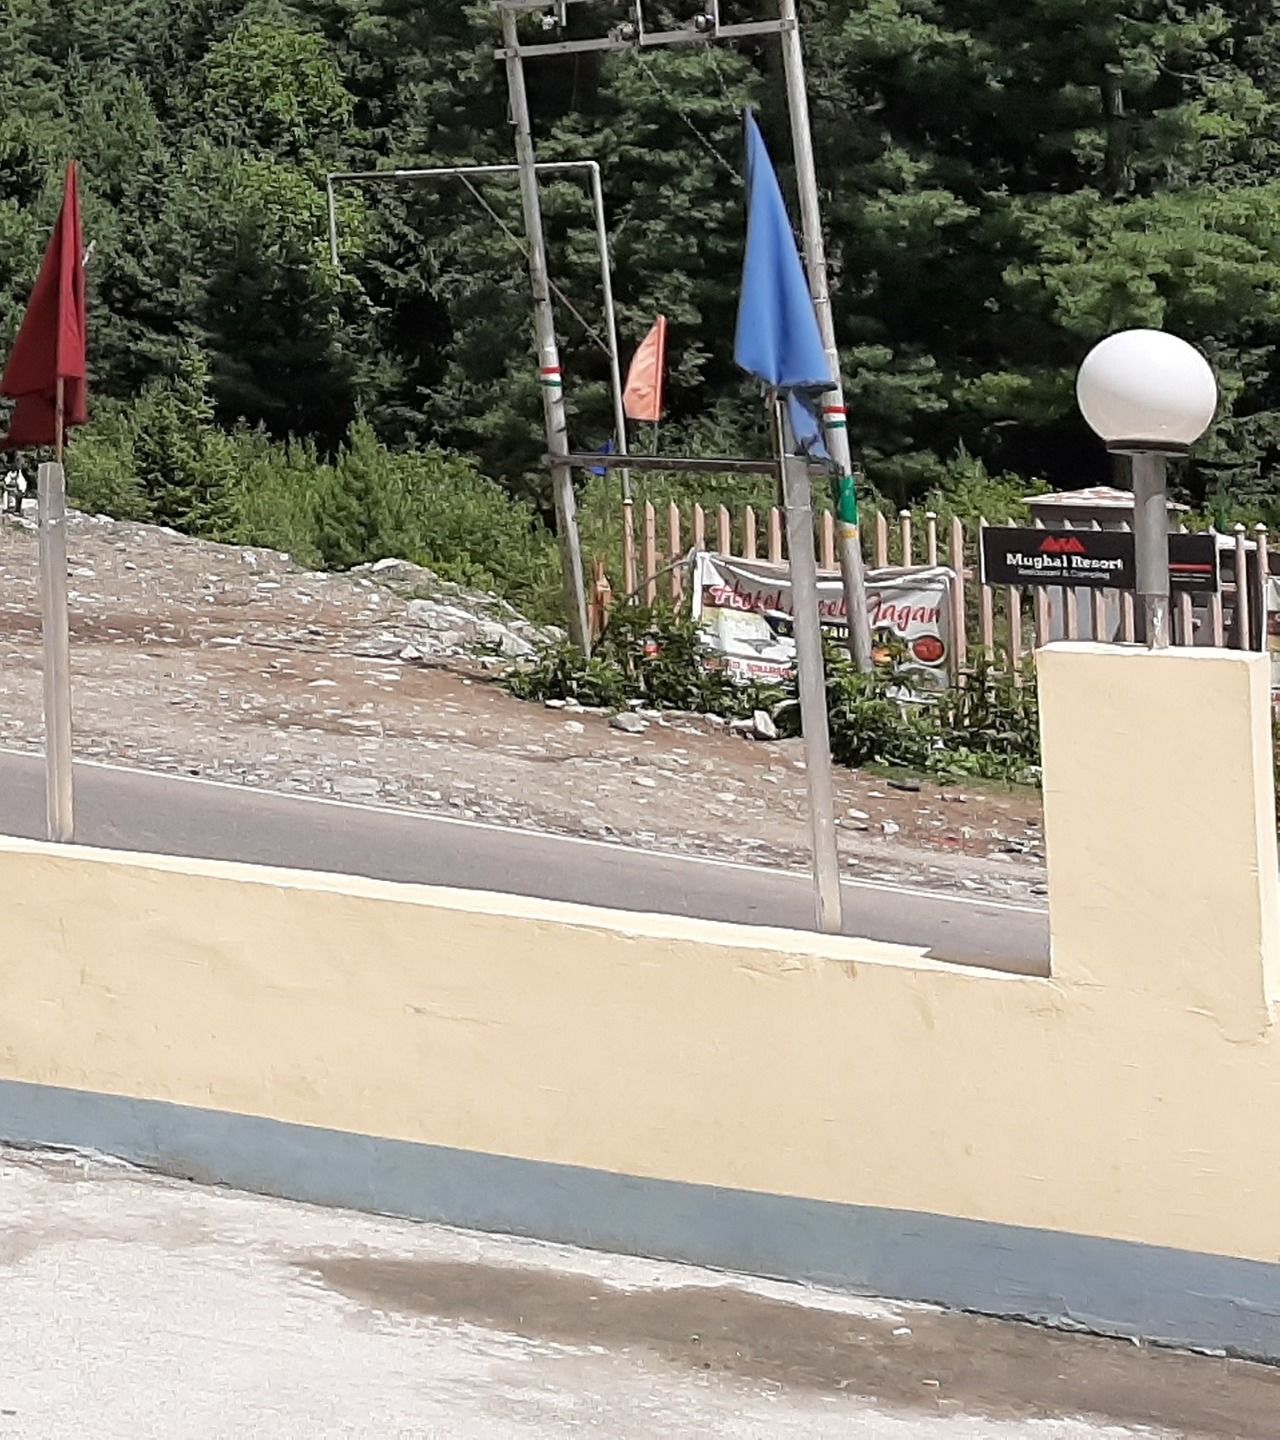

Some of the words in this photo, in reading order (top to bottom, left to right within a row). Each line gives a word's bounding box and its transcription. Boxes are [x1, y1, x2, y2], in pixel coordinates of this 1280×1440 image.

[1006, 553, 1068, 569] Mughal
[1071, 555, 1124, 570] Resort
[709, 579, 784, 610] Hotel
